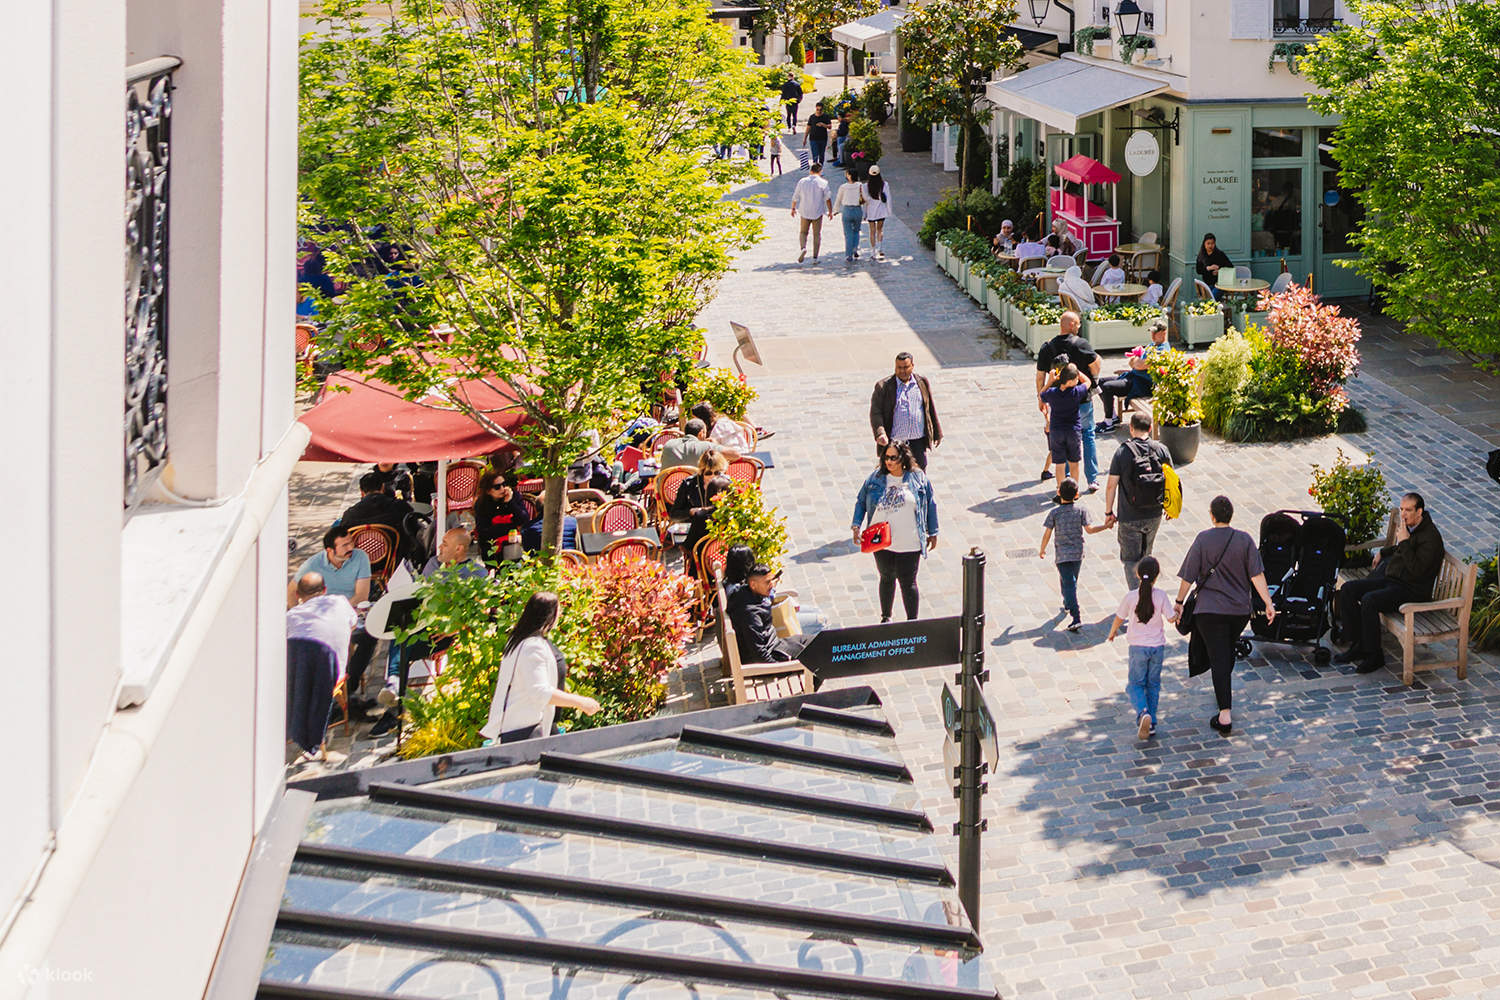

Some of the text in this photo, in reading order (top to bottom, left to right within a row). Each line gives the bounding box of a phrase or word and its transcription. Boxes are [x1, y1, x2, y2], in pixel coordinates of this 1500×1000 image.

[1202, 176, 1239, 184] LADURÉE
[832, 635, 927, 653] BUREAUX ADMINISTRATIFS
[831, 646, 915, 662] MANAGEMENT OFFICE
